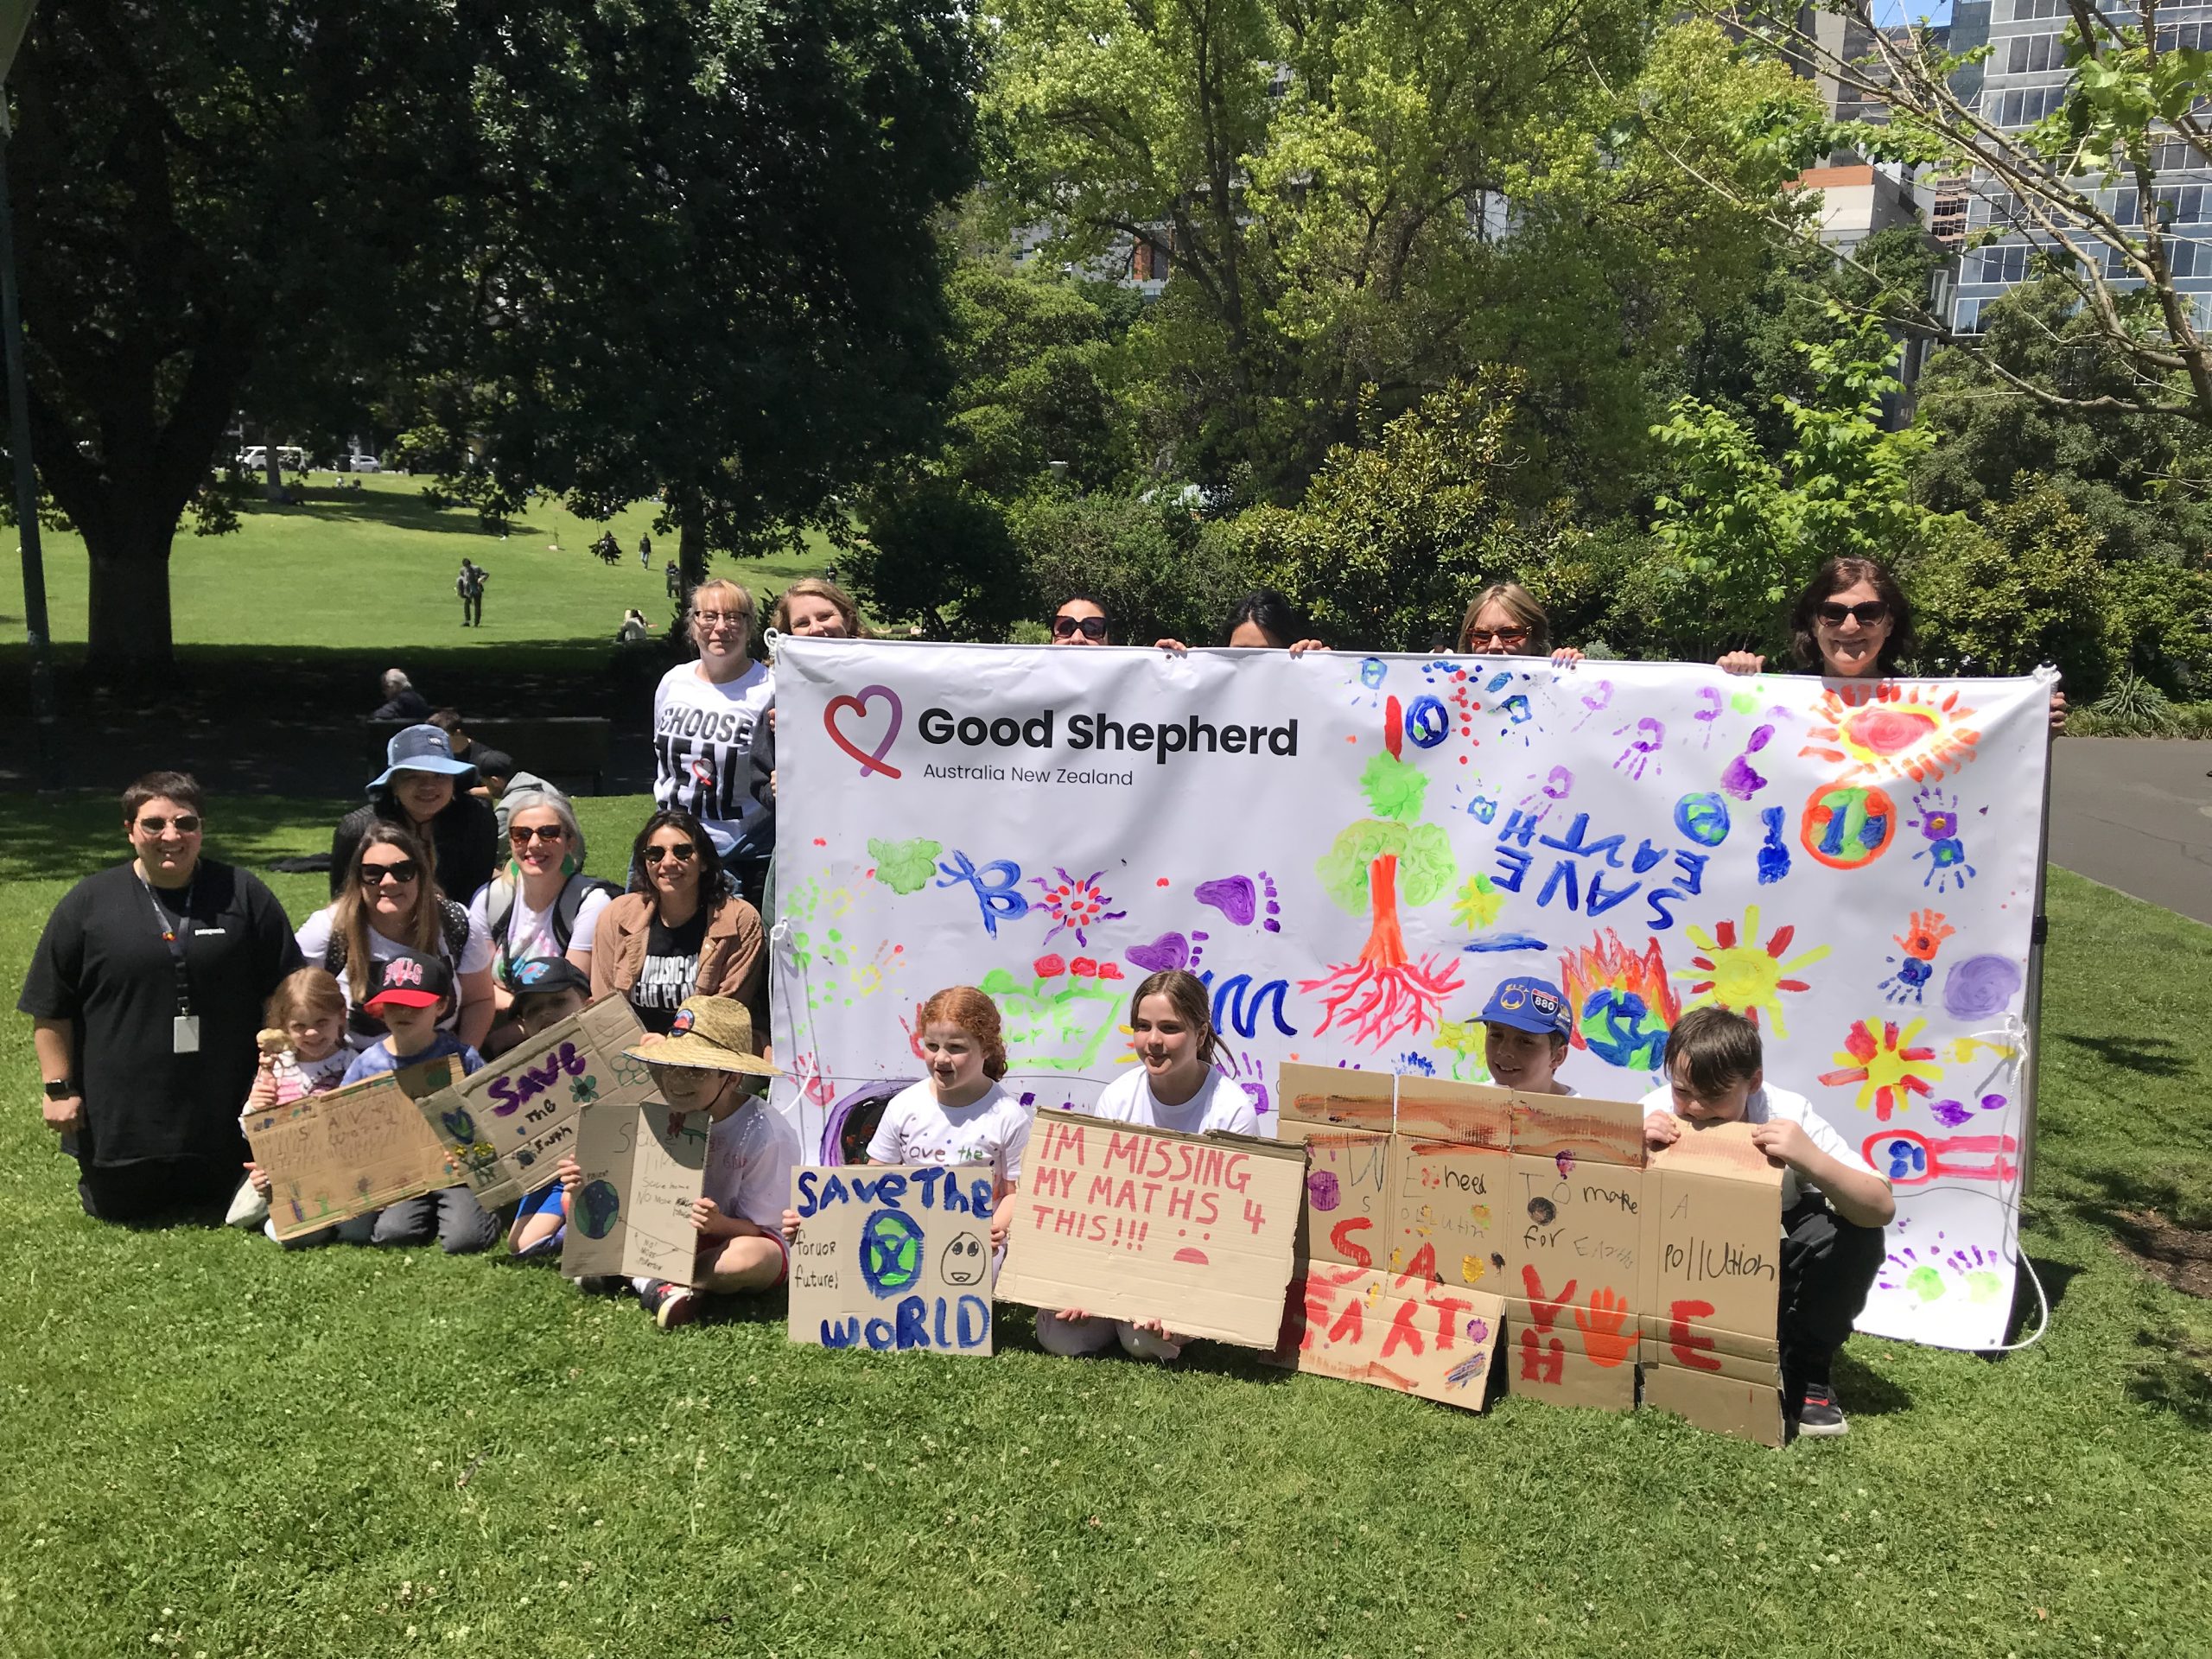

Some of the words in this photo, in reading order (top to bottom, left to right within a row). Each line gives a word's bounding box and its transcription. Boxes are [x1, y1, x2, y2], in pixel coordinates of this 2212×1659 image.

[658, 707, 753, 746] CHOOSE
[918, 708, 1053, 750] Good
[1067, 714, 1298, 765] Shepherd
[923, 763, 1005, 781] Australia
[1011, 768, 1051, 784] New
[1056, 768, 1134, 785] Zealand
[640, 955, 685, 985] MUSIC
[631, 982, 659, 1008] EAD
[1535, 996, 1554, 1011] 880
[957, 1145, 983, 1163] the
[1040, 1123, 1085, 1166] I'M
[1103, 1131, 1252, 1194] MISSING
[1033, 1166, 1077, 1199] MY
[1087, 1175, 1219, 1225] MATHS
[1243, 1198, 1266, 1235] 4
[1032, 1205, 1149, 1251] THIS!!!
[1523, 1224, 1567, 1249] for
